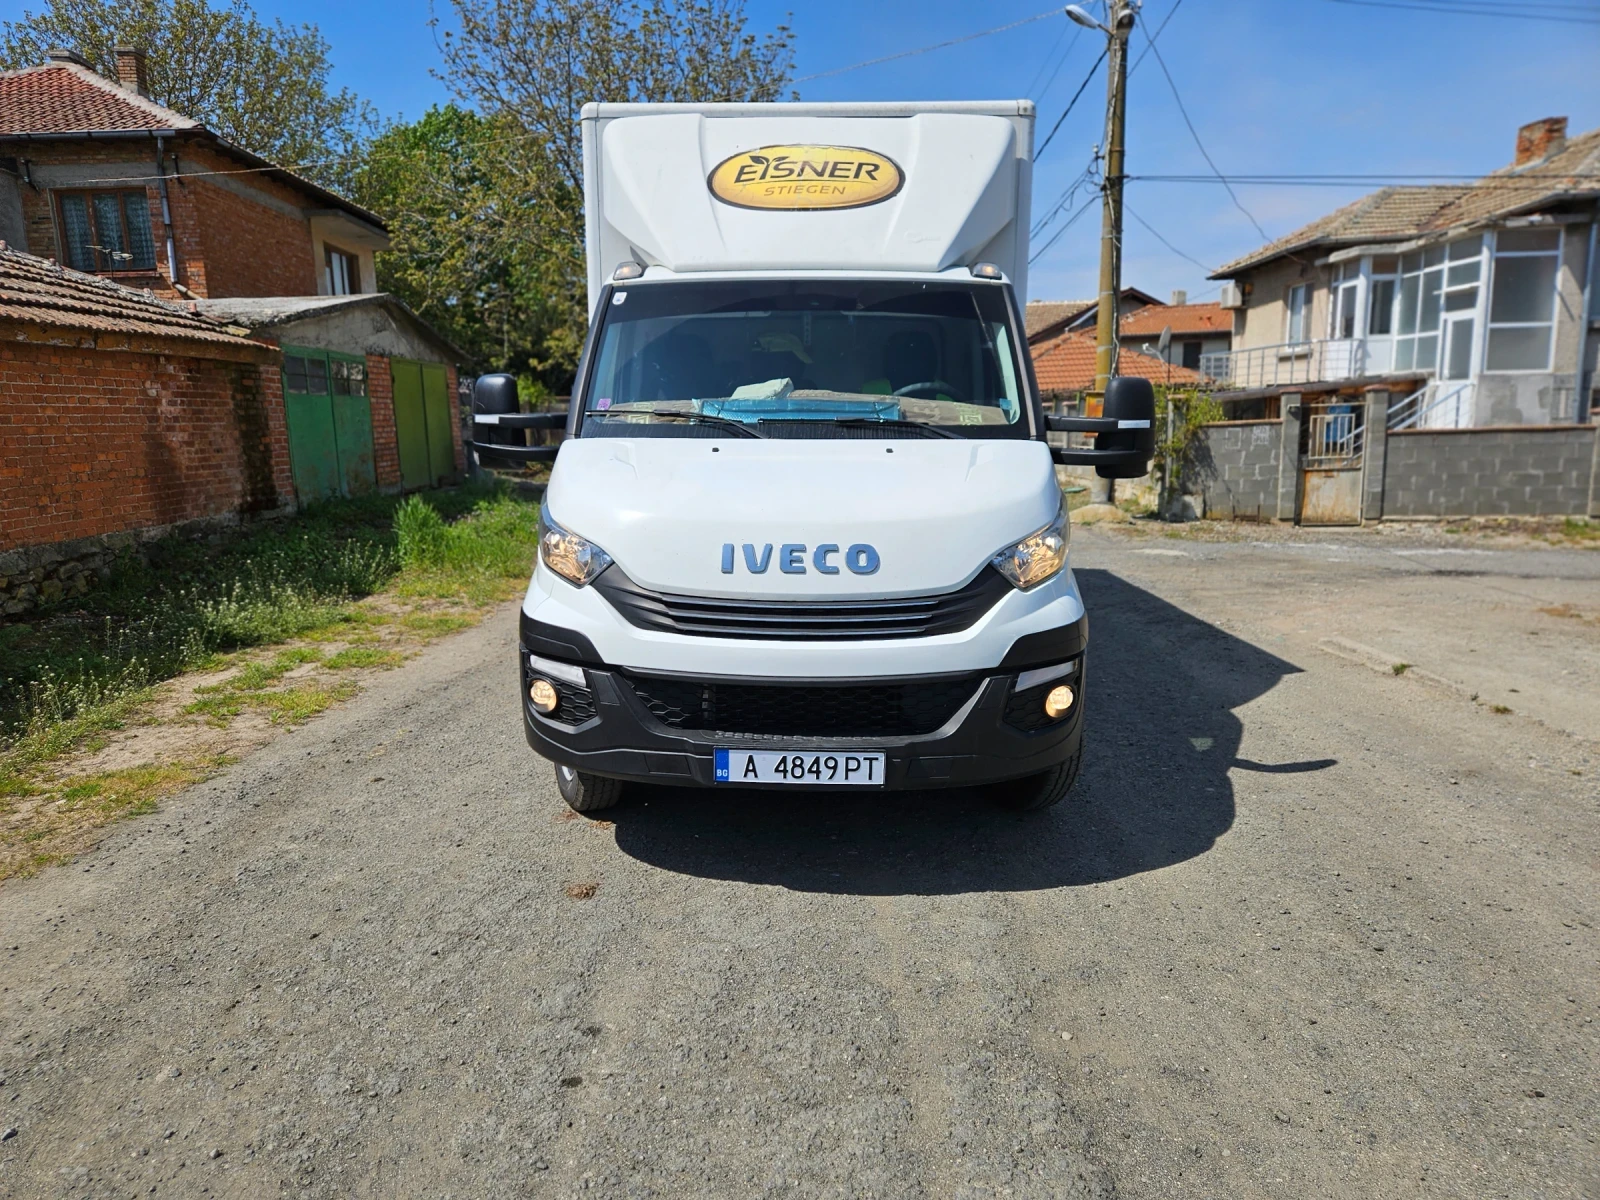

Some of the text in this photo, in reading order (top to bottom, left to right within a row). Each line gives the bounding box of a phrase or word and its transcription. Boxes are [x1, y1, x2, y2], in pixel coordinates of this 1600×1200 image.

[763, 185, 847, 196] STIEGEN
[721, 543, 881, 574] IVECO
[716, 769, 728, 777] BG
[743, 754, 758, 779] A
